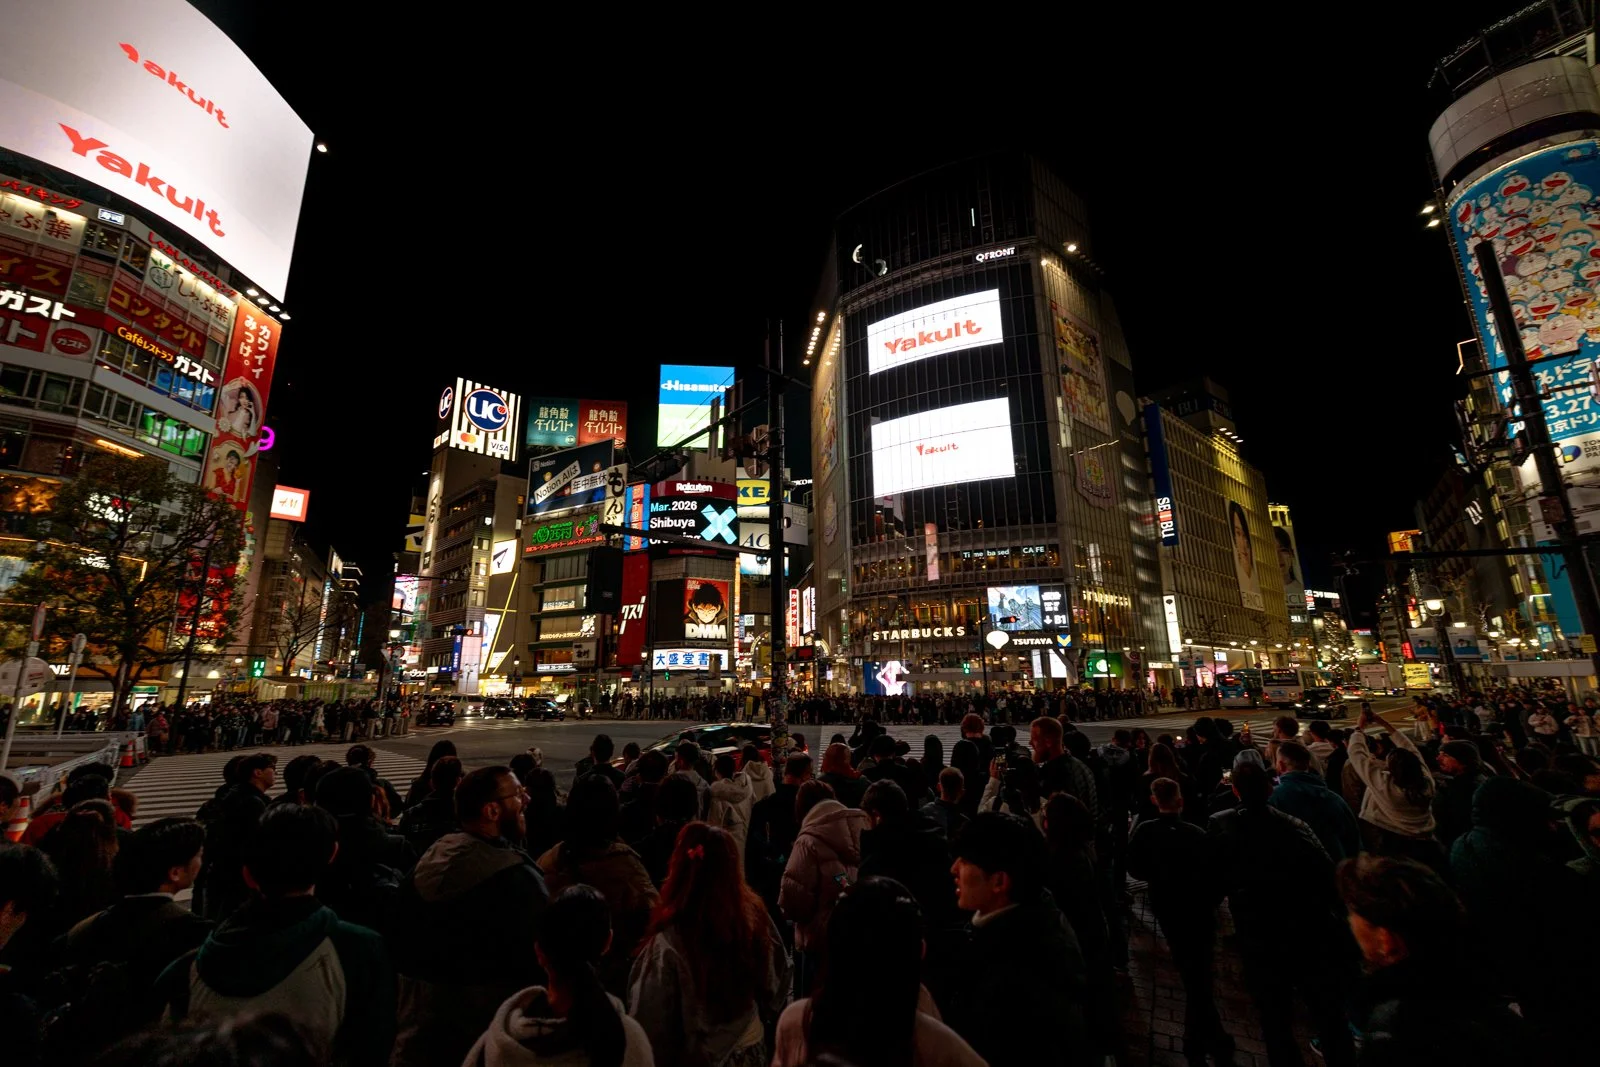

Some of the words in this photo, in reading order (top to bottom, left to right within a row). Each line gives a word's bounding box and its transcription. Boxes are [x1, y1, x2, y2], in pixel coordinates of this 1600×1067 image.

[58, 122, 226, 238] Yakult
[975, 246, 1016, 263] QFRONT
[0, 289, 76, 321] ガスト
[110, 287, 203, 348] コンタクト
[239, 314, 257, 366] みつけ。
[884, 319, 983, 355] Yakult
[251, 325, 272, 379] カワイイ
[174, 355, 215, 383] ガスト
[661, 380, 734, 393] Hisamits
[469, 396, 507, 423] UC
[491, 441, 509, 452] VISA
[916, 442, 959, 456] Yakult
[540, 459, 556, 467] Notion
[572, 472, 608, 490] 年中無休
[676, 483, 713, 493] Rakuten
[535, 479, 562, 501] Notion
[650, 502, 671, 512] Mar.
[671, 500, 698, 511] 2026
[649, 516, 696, 529] Shibuya
[1156, 497, 1175, 539] SEIBU
[619, 595, 646, 635] クスリ
[1054, 614, 1066, 625] B1
[685, 623, 727, 639] DMM
[872, 626, 965, 641] STARBUCKS
[656, 652, 723, 666] 大盛堂書
